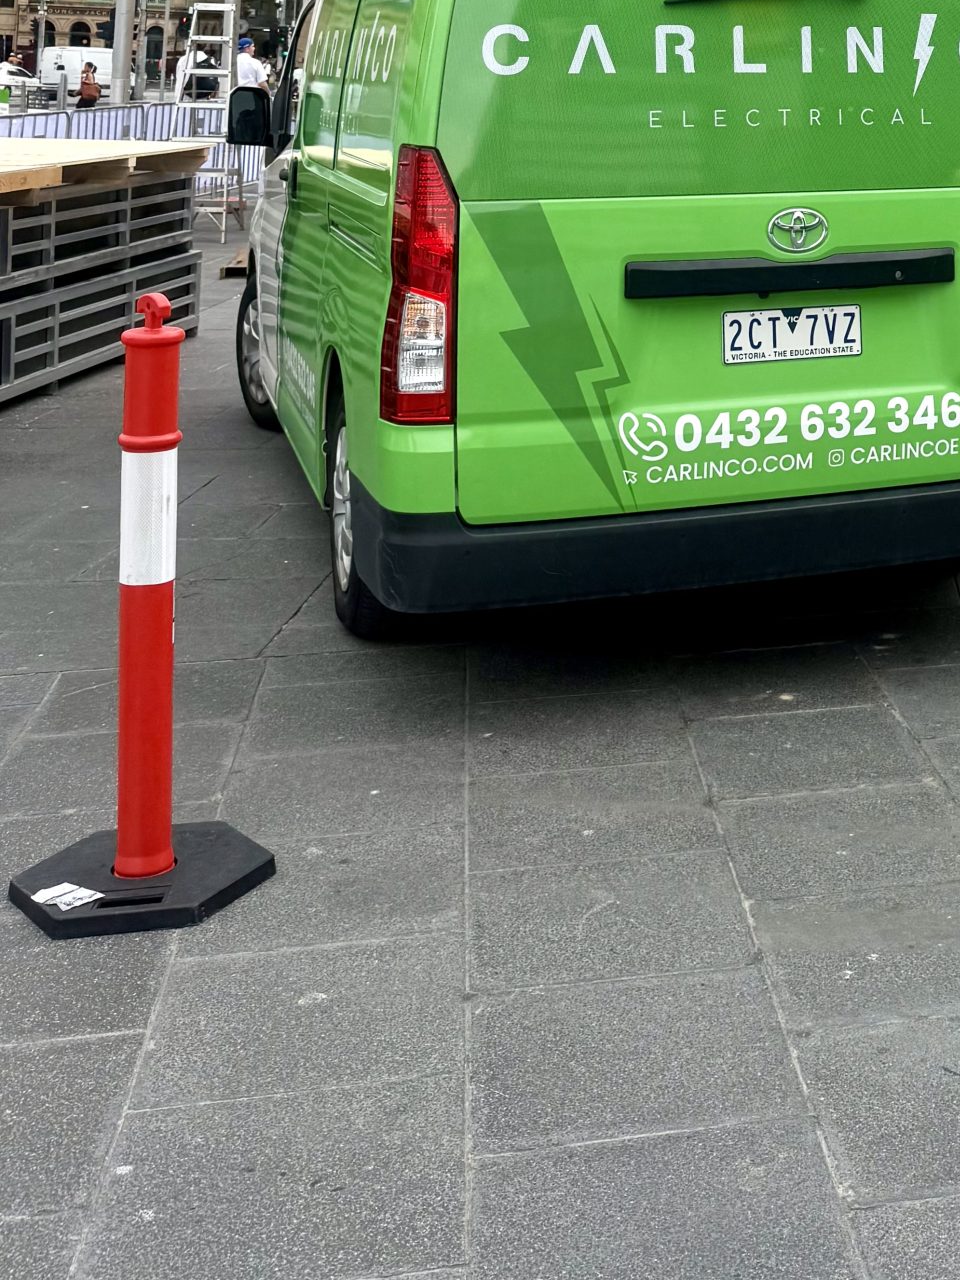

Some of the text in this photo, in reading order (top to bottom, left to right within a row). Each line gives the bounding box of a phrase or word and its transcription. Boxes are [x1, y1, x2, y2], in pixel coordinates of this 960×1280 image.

[648, 107, 932, 129] ELECTRICAL
[729, 312, 856, 352] 2CT 7VZ
[785, 315, 799, 323] VIC
[731, 351, 766, 361] VICTORIA
[774, 350, 788, 358] THE
[790, 348, 831, 357] EDUCATION
[833, 345, 854, 354] STATE
[674, 406, 788, 452] 0432
[800, 399, 876, 441] 632
[646, 438, 960, 484] CARLINCO.COM CARLINCOE
